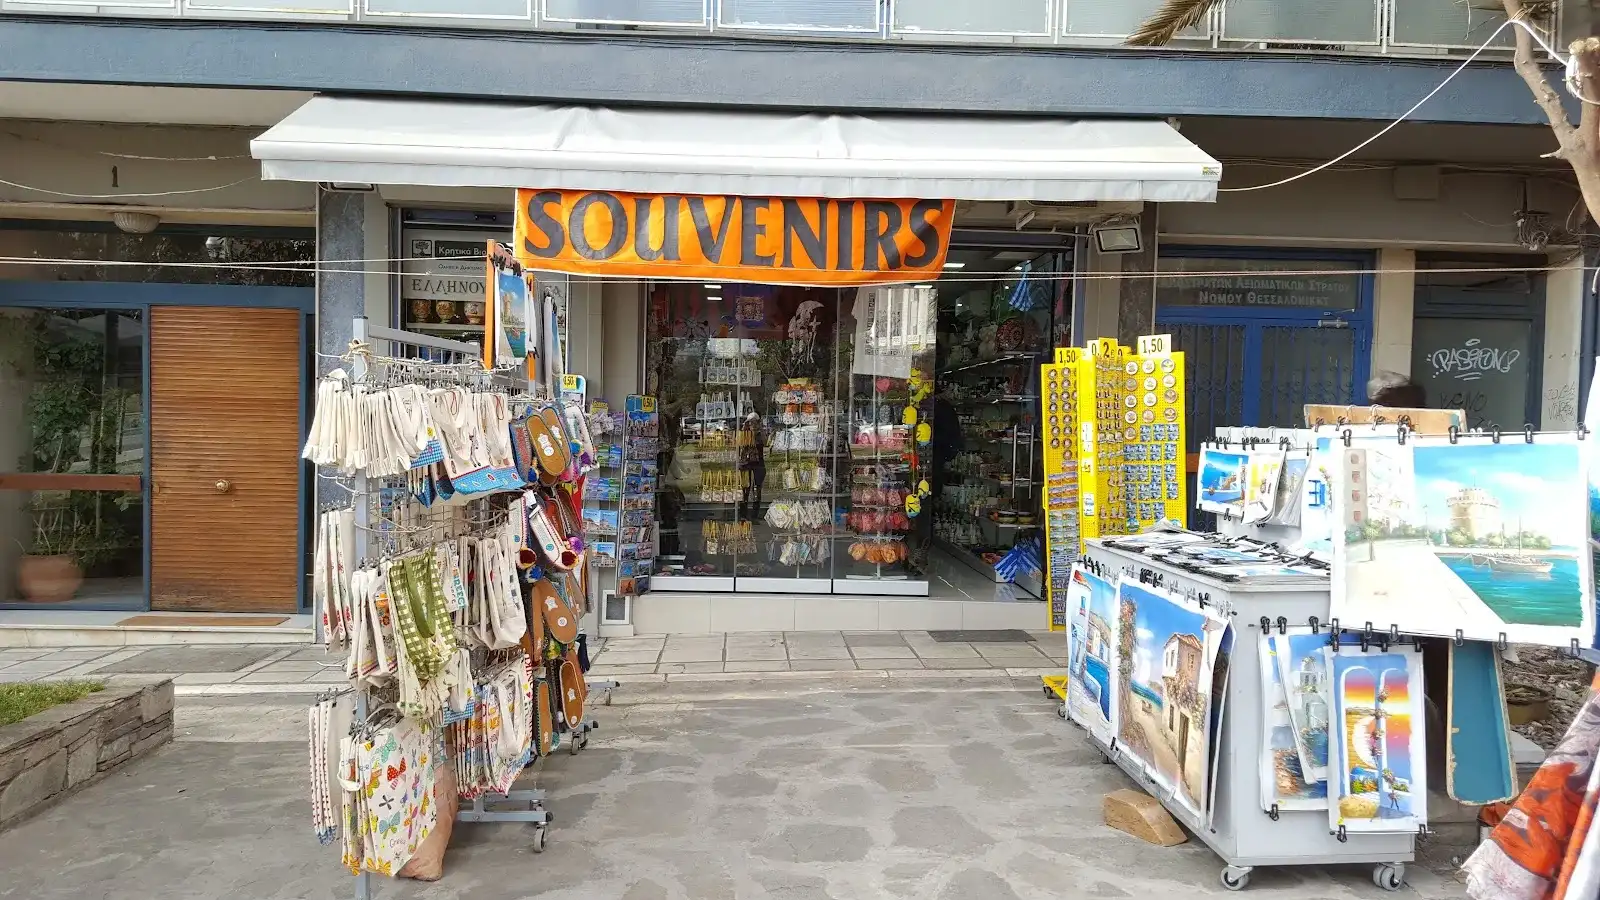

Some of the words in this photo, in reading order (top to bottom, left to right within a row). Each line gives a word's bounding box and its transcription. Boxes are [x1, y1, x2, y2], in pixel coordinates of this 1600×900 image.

[524, 190, 945, 271] SOUVENIRS
[438, 246, 471, 256] Κρητικά
[473, 247, 487, 256] Βιο
[1199, 291, 1243, 305] ΝΟΜΟΥ
